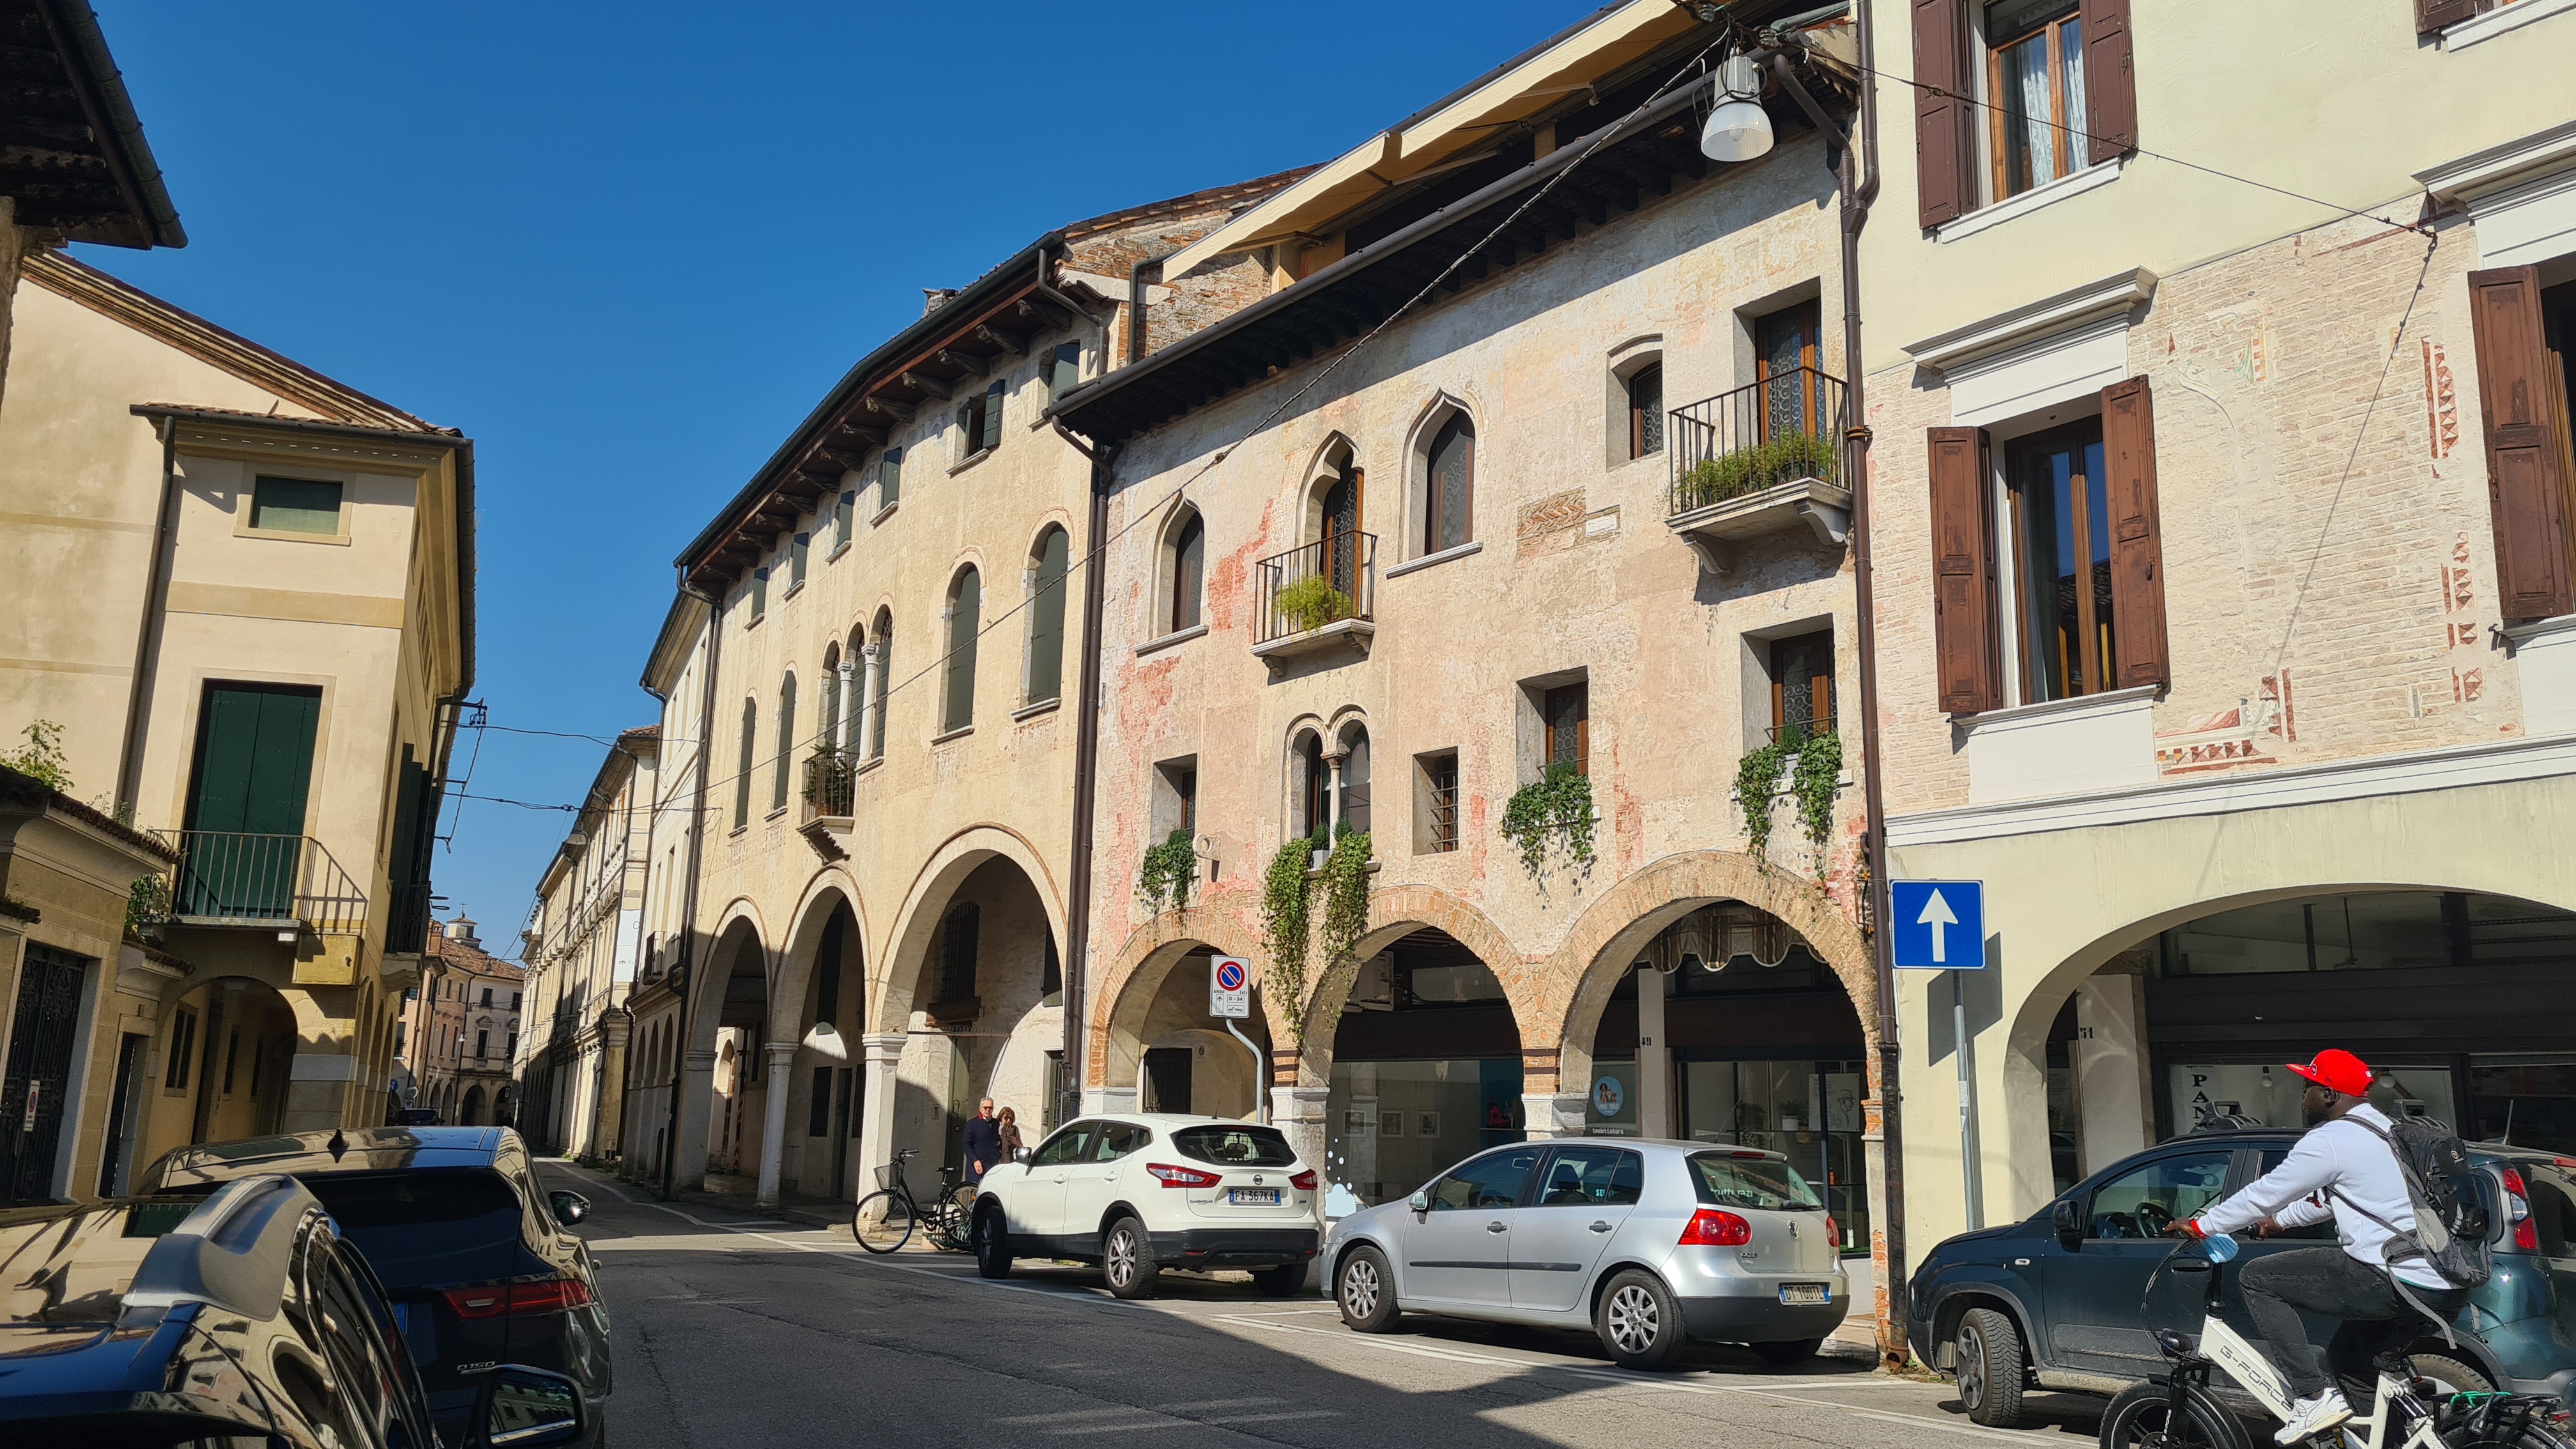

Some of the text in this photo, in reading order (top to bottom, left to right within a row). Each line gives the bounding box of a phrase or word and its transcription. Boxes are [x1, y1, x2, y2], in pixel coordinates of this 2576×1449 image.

[2080, 1027, 2094, 1039] 51
[1642, 1037, 1652, 1046] 49
[1235, 1190, 1246, 1201] FA
[1249, 1190, 1274, 1202] 367KA
[1784, 1285, 1823, 1300] DT 100TL
[2220, 1345, 2294, 1412] G-FORCE
